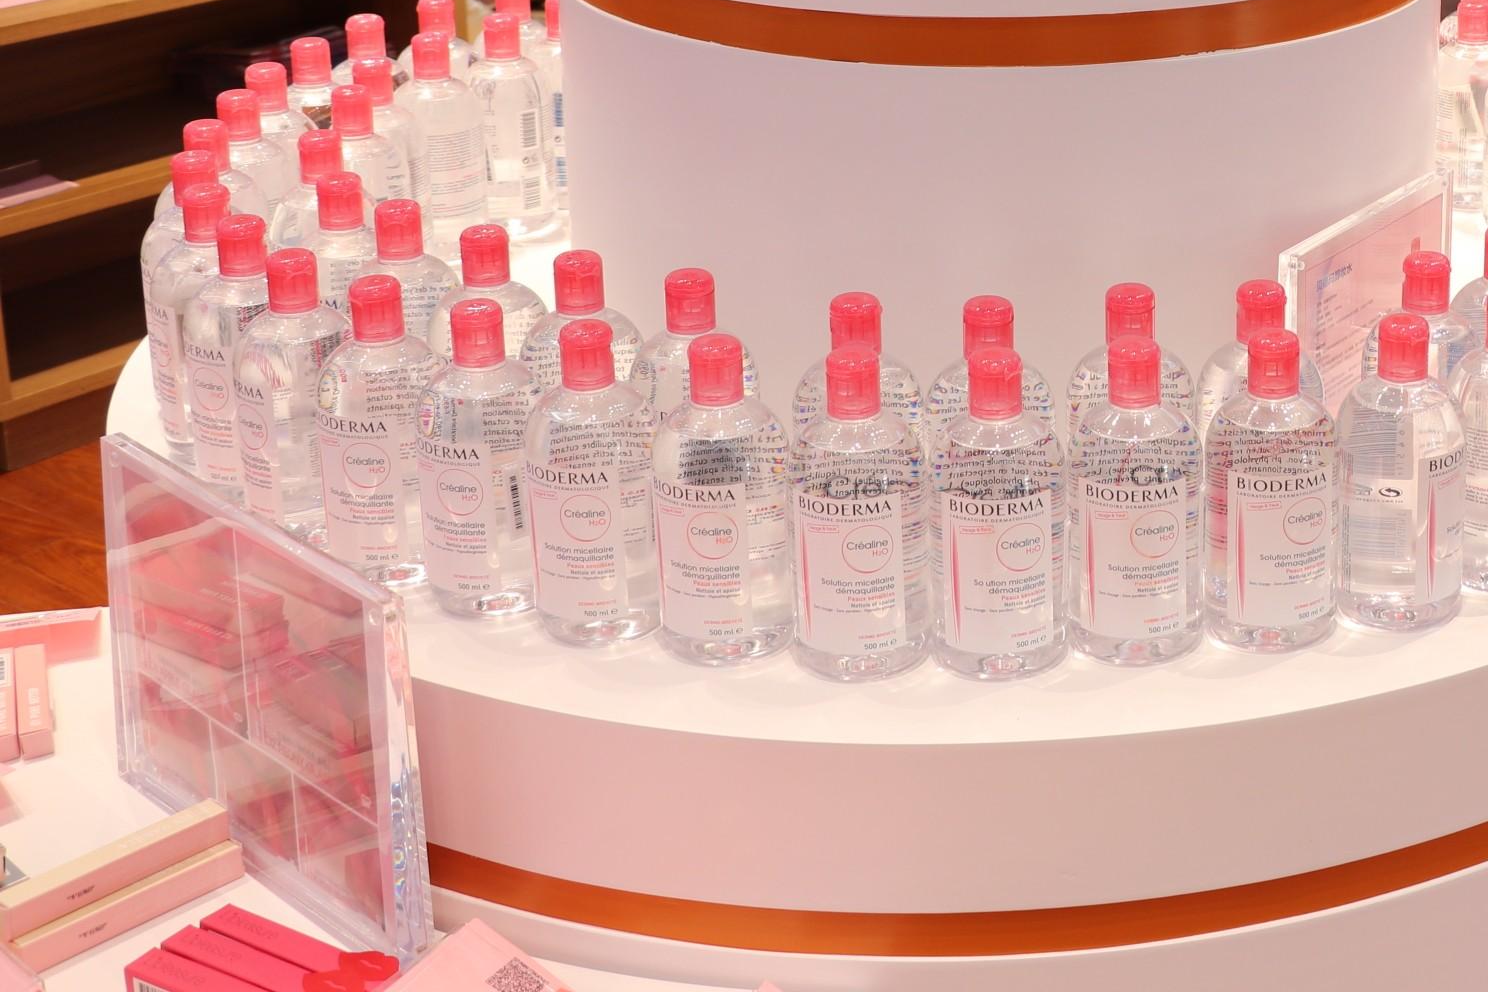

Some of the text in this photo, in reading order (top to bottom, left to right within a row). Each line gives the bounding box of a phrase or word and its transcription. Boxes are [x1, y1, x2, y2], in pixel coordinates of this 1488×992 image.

[345, 456, 385, 466] Créaline
[439, 482, 477, 494] Créaline
[1237, 473, 1327, 492] BIODERMA
[1086, 484, 1179, 503] BIODERMA
[799, 496, 892, 516] BIODERMA
[950, 498, 1044, 516] BIODERMA
[563, 509, 606, 519] Créaline
[1287, 511, 1323, 524] Créaline
[691, 527, 732, 537] Créaline
[1135, 523, 1175, 537] Créaline
[846, 538, 889, 551] Créaline
[1000, 536, 1041, 549] Créaline
[1260, 553, 1292, 562] Solution
[1108, 564, 1140, 573] Solution
[821, 575, 895, 587] Solution micellaire
[974, 578, 1007, 586] Soution
[1148, 625, 1162, 634] 500
[1016, 640, 1029, 648] 500
